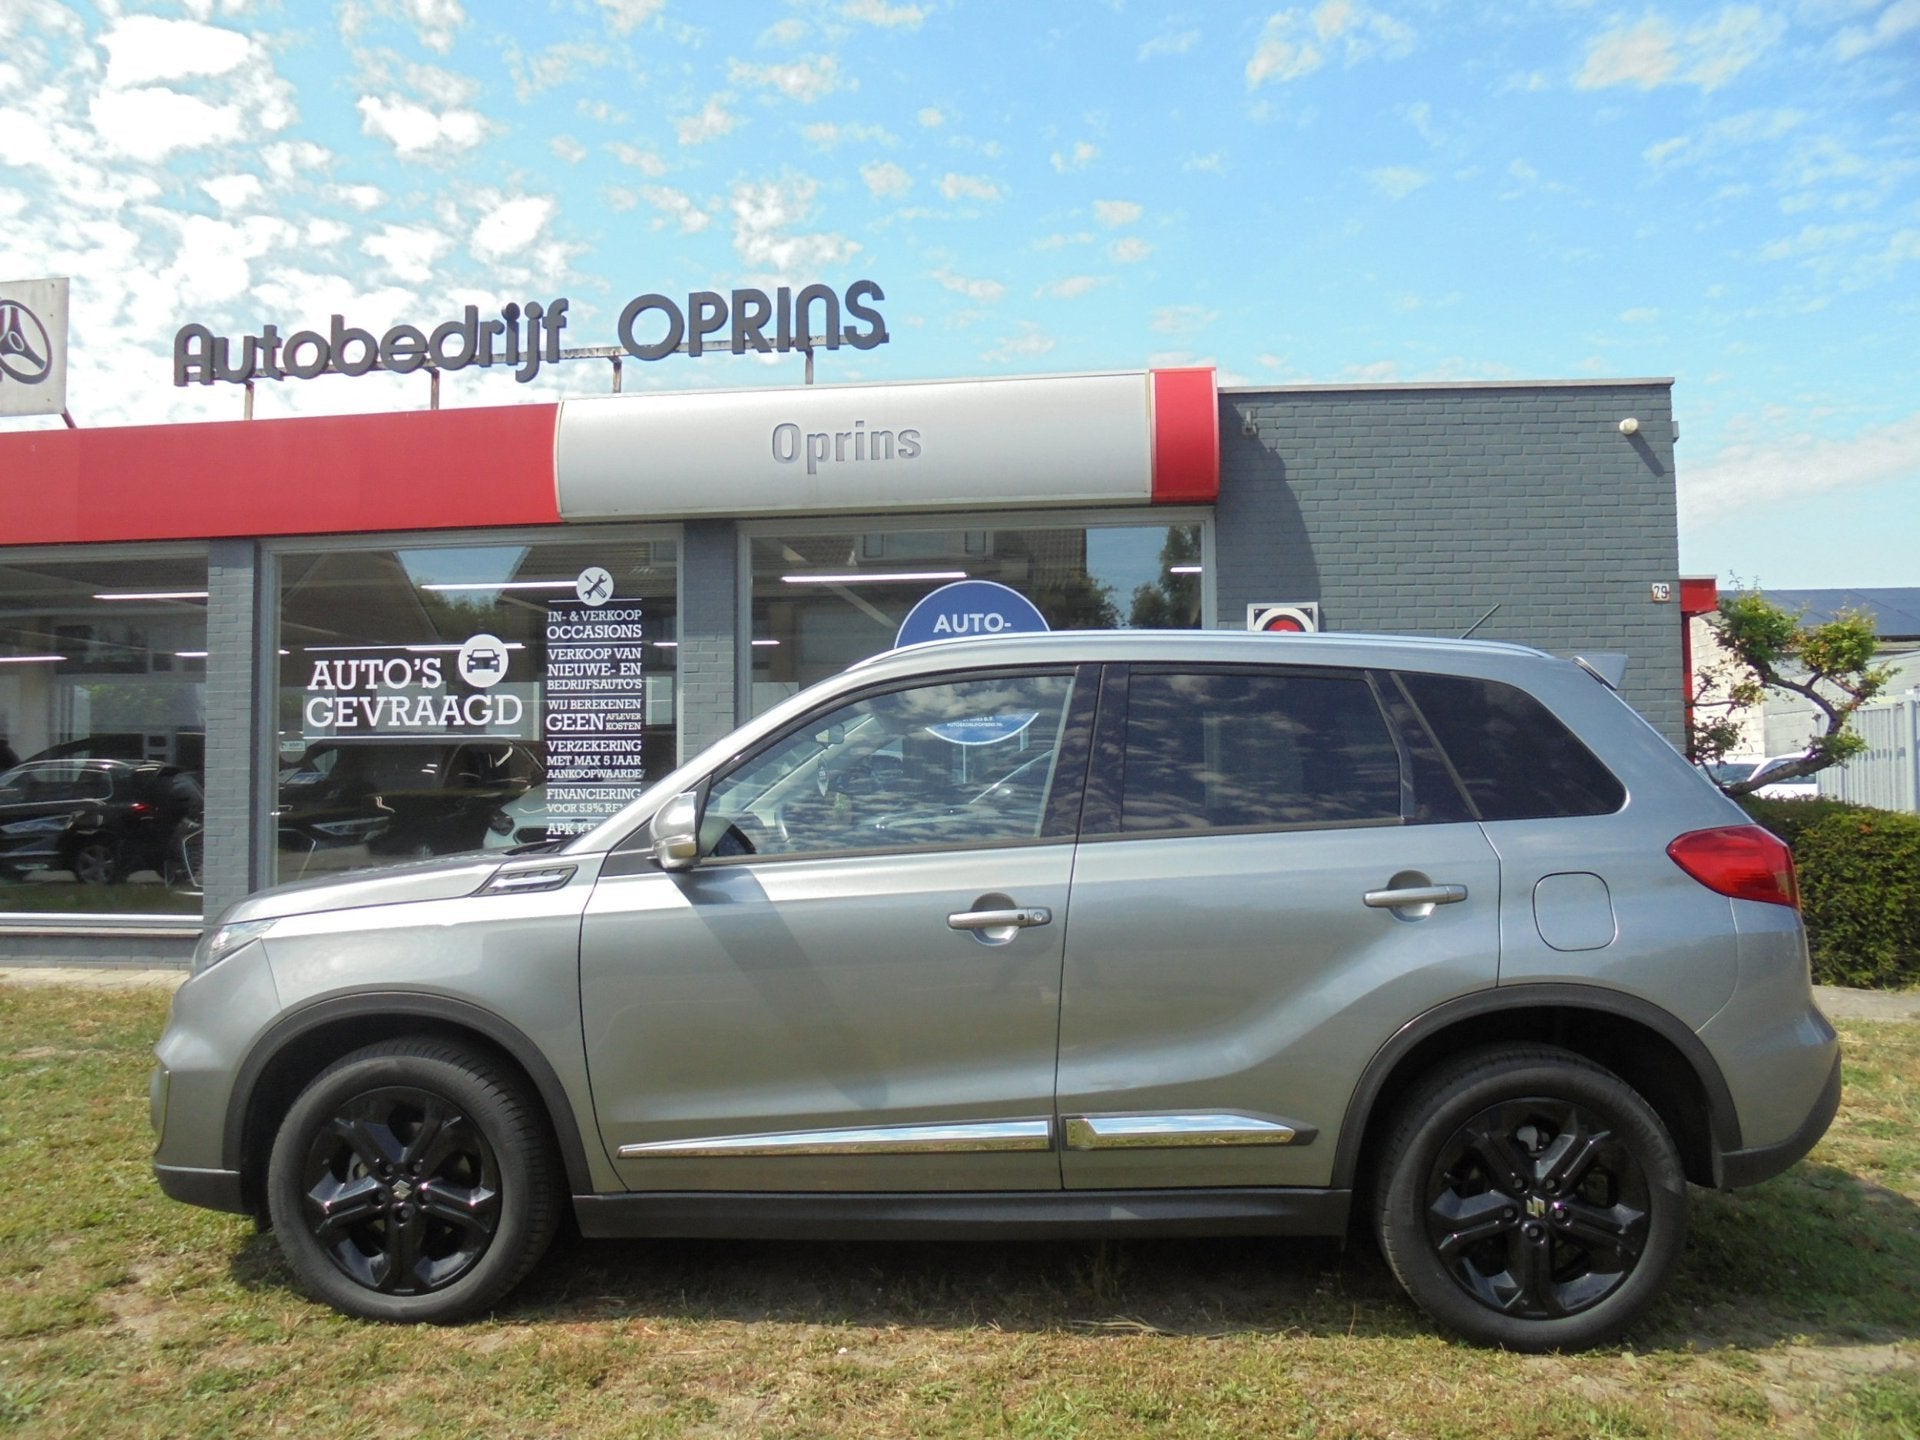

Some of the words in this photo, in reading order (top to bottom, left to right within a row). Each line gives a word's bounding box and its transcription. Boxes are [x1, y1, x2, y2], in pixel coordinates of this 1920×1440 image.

[174, 298, 569, 387] Autobedrijf
[618, 280, 887, 361] OPRINS
[772, 420, 922, 475] Oprins
[1653, 585, 1668, 599] 29
[547, 611, 567, 622] IN-
[569, 611, 579, 622] &
[580, 609, 642, 621] VERKOOP
[933, 613, 1012, 633] AUTO-
[546, 624, 642, 639] OCCASIONS
[547, 648, 612, 660] VERKOOP
[613, 647, 642, 659] VAN
[307, 657, 442, 690] AUTO'S
[547, 662, 617, 677] NIEUWE-
[619, 662, 642, 676] EN
[547, 679, 642, 690] BEDRIJFSAUTO'S
[306, 694, 523, 727] GEVRAAGD
[547, 700, 568, 710] WIJ
[570, 699, 641, 710] BEREKENEN
[546, 713, 605, 731] GEEN
[606, 722, 642, 730] KOSTEN
[546, 740, 642, 752] VERZEKERING
[546, 755, 572, 766] MET
[574, 755, 601, 766] MAX
[603, 755, 611, 765] 5
[612, 755, 641, 765] JAAR
[546, 769, 642, 779] AANKOOPWAARDE
[546, 788, 641, 800] FINANCIERING
[547, 803, 577, 813] VOOR
[546, 822, 574, 835] APK
